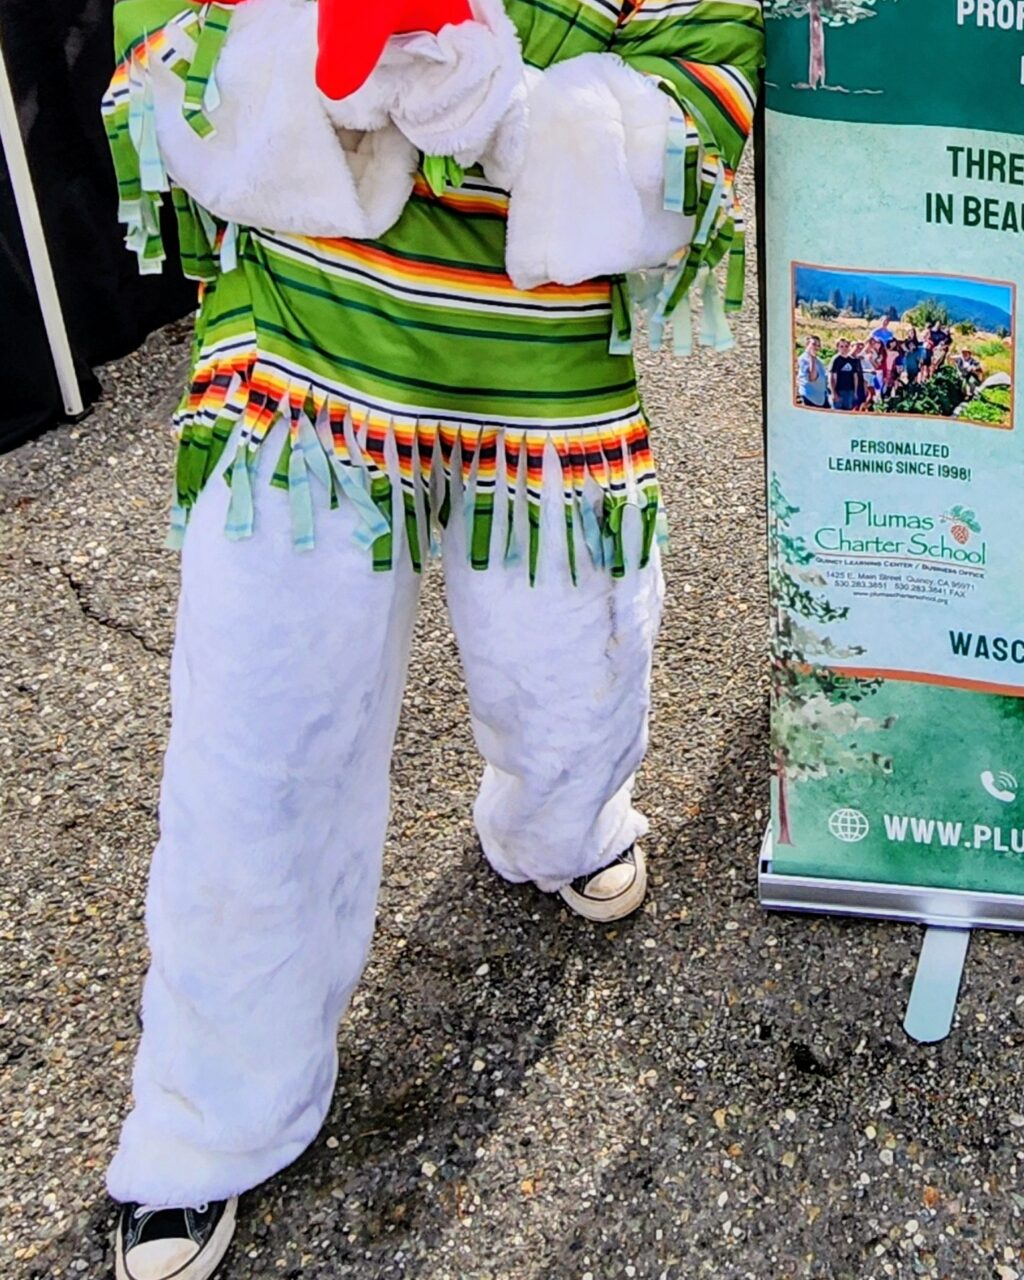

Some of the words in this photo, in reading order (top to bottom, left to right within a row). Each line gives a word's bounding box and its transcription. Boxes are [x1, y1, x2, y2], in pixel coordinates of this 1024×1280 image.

[925, 192, 953, 224] IN
[851, 440, 949, 458] PERSONALIZED
[828, 457, 893, 473] LEARNING
[896, 461, 934, 476] SINCE
[938, 465, 971, 482] 1998!
[844, 501, 934, 530] Plumas
[815, 528, 905, 553] Charter
[907, 533, 986, 565] School
